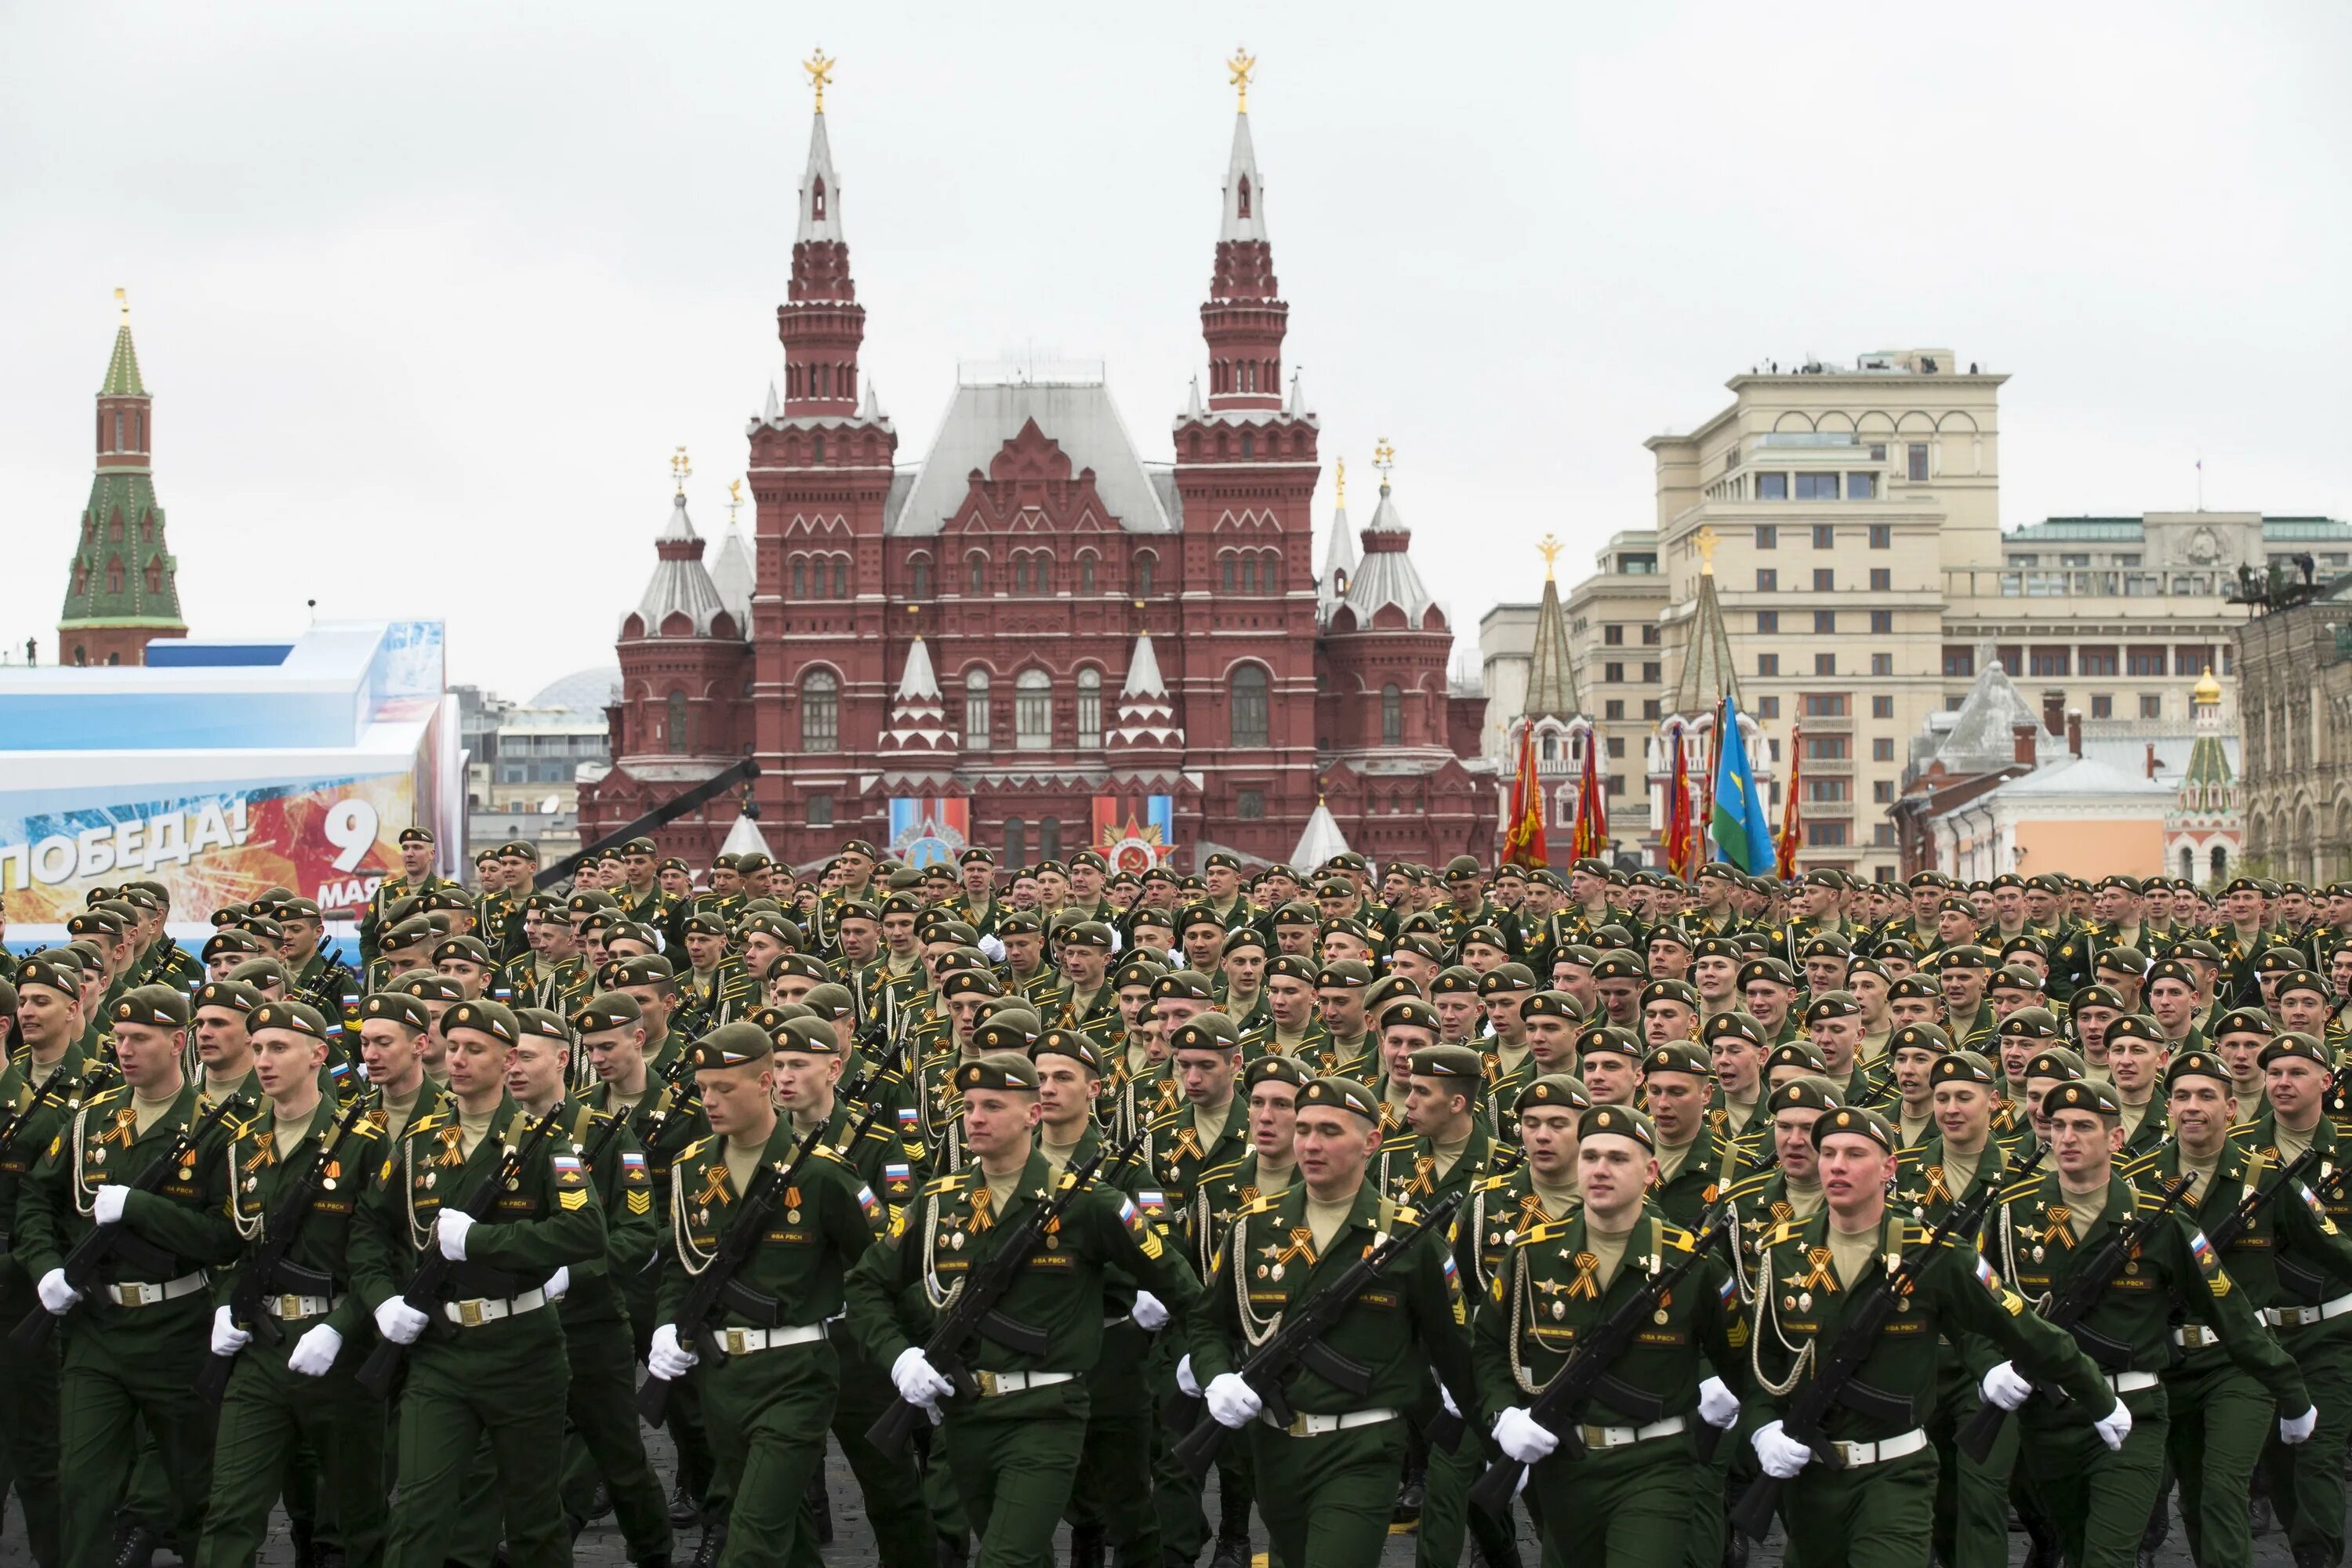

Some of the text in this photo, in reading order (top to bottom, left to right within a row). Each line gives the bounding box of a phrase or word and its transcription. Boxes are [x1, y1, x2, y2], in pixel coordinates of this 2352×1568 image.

[0, 798, 249, 893] ПОБЕДА!
[325, 799, 378, 873] 9
[318, 877, 381, 909] МАЯ
